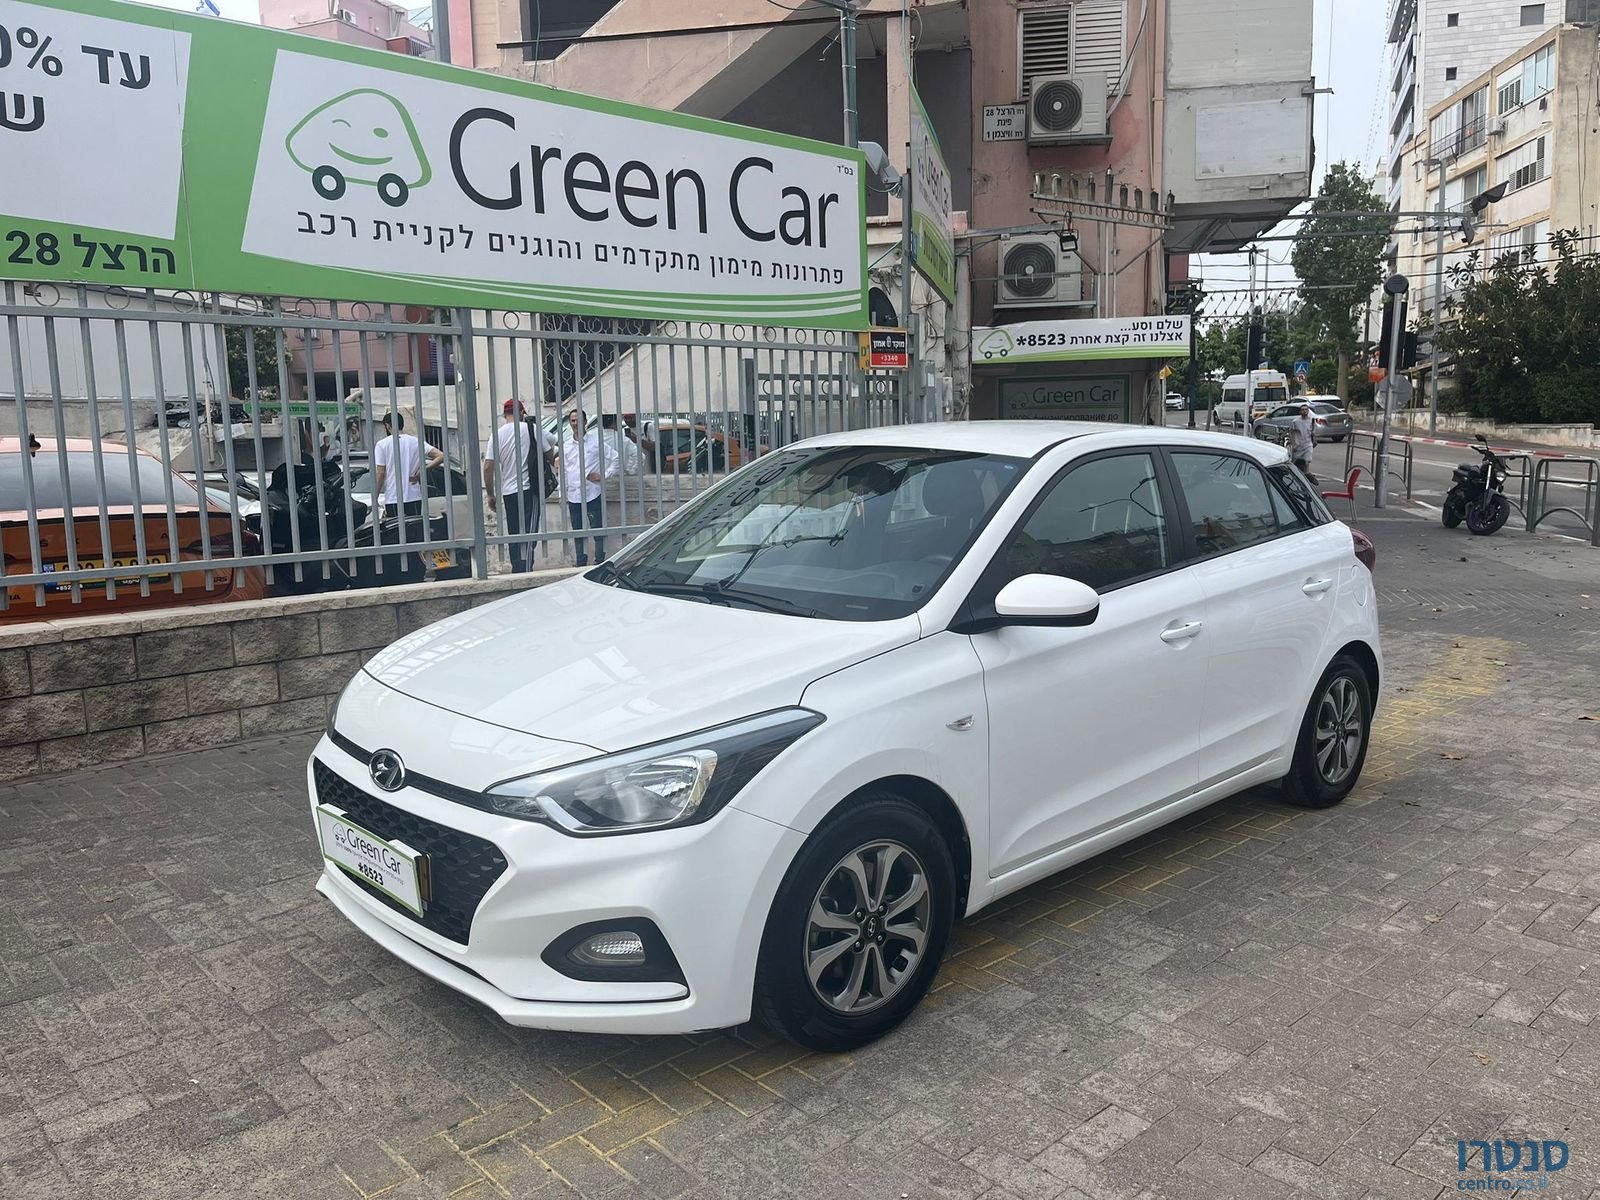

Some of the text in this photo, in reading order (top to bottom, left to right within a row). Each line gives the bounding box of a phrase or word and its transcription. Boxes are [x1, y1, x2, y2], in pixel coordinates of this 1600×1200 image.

[81, 45, 151, 90] עד
[449, 107, 839, 248] Green Car
[5, 230, 176, 275] הרצל 28
[297, 211, 844, 284] פתרונות מימון מתקדמים והוגנים לקניית רכב
[1120, 319, 1183, 332] שלם וסע...
[1069, 335, 1102, 345] אחרת
[1105, 334, 1130, 346] קצת
[1133, 333, 1147, 343] זה
[1150, 331, 1183, 342] אצלנו
[892, 341, 905, 349] מוקד
[1032, 385, 1120, 404] Green Car
[346, 828, 401, 875] Green Car
